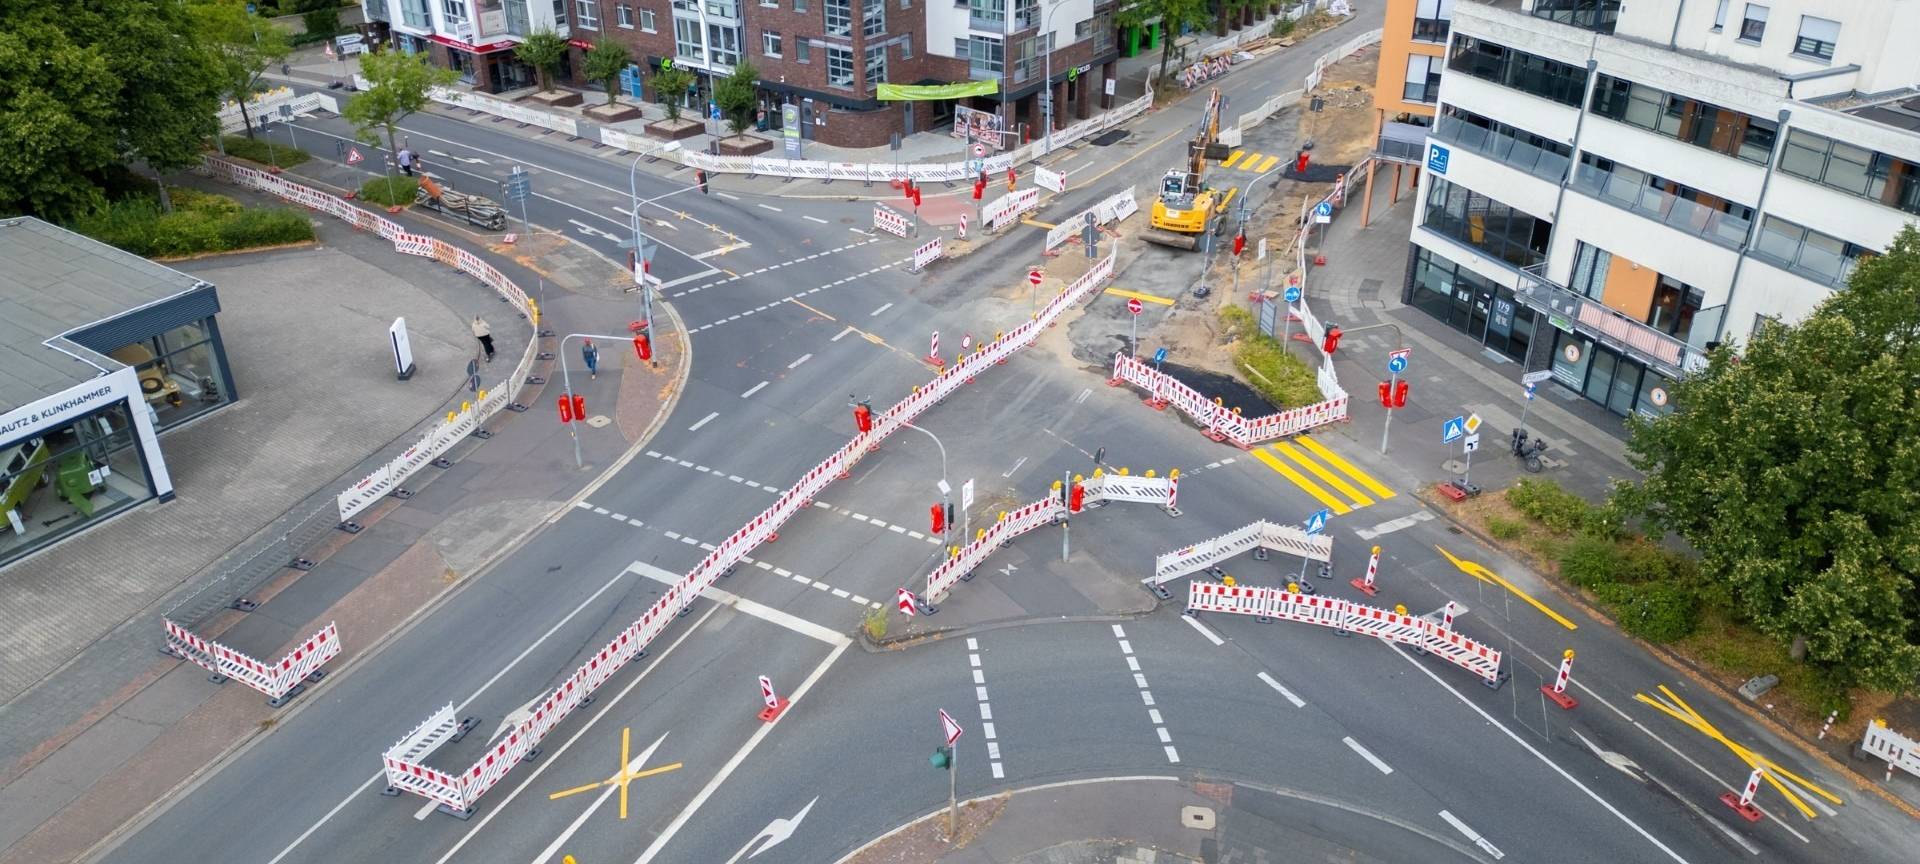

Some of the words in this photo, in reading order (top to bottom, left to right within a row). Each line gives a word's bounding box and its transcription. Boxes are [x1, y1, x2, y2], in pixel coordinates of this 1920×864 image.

[1430, 148, 1439, 161] P
[1497, 300, 1510, 313] 179
[31, 414, 39, 423] &
[41, 386, 112, 419] KLINKHAMMER
